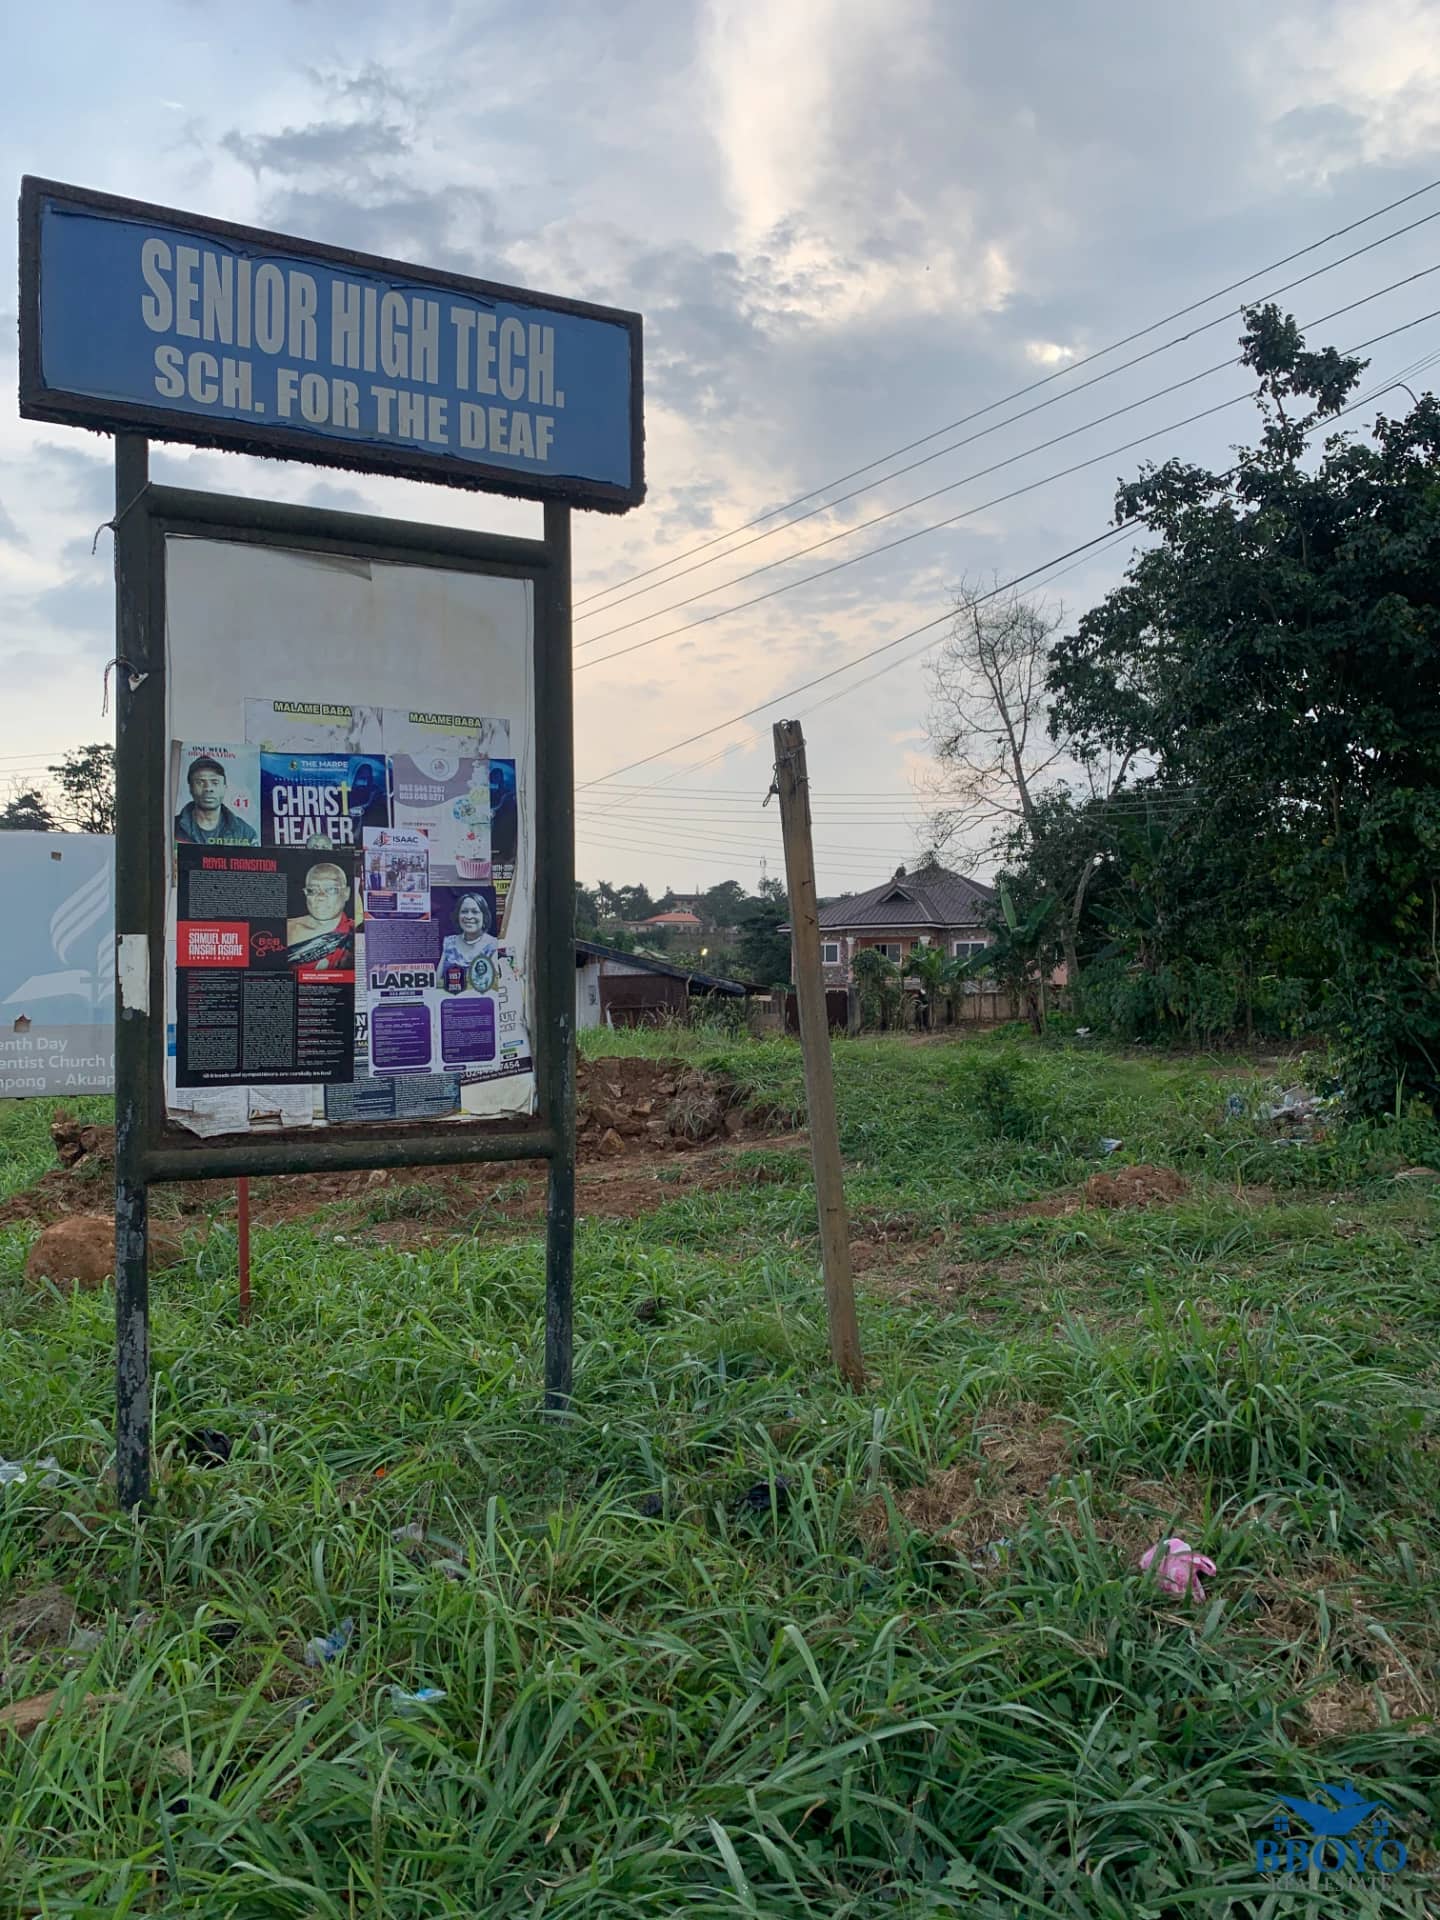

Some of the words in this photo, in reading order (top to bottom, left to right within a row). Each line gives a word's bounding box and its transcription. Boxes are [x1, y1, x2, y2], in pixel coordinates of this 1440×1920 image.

[141, 238, 318, 361] SENIOR
[331, 279, 440, 384] HIGH
[451, 306, 565, 408] TECH.
[154, 345, 265, 413] SCH.
[277, 367, 360, 429] FOR
[370, 385, 449, 444] THE
[459, 402, 555, 461] DEAF
[273, 700, 321, 715] MALAME
[321, 704, 353, 717] BABA
[409, 712, 453, 726] MALAME
[454, 716, 482, 728] BABA
[272, 781, 352, 816] CHRIST
[274, 816, 355, 845] HEALER
[392, 835, 419, 844] ISAAC
[202, 856, 227, 870] ROYAL
[230, 858, 277, 872] TRANSITION
[188, 932, 220, 945] SAMUEL
[222, 933, 239, 945] KOFI
[370, 971, 436, 990] LARBI
[37, 1038, 69, 1053] Day
[48, 1054, 106, 1068] Church
